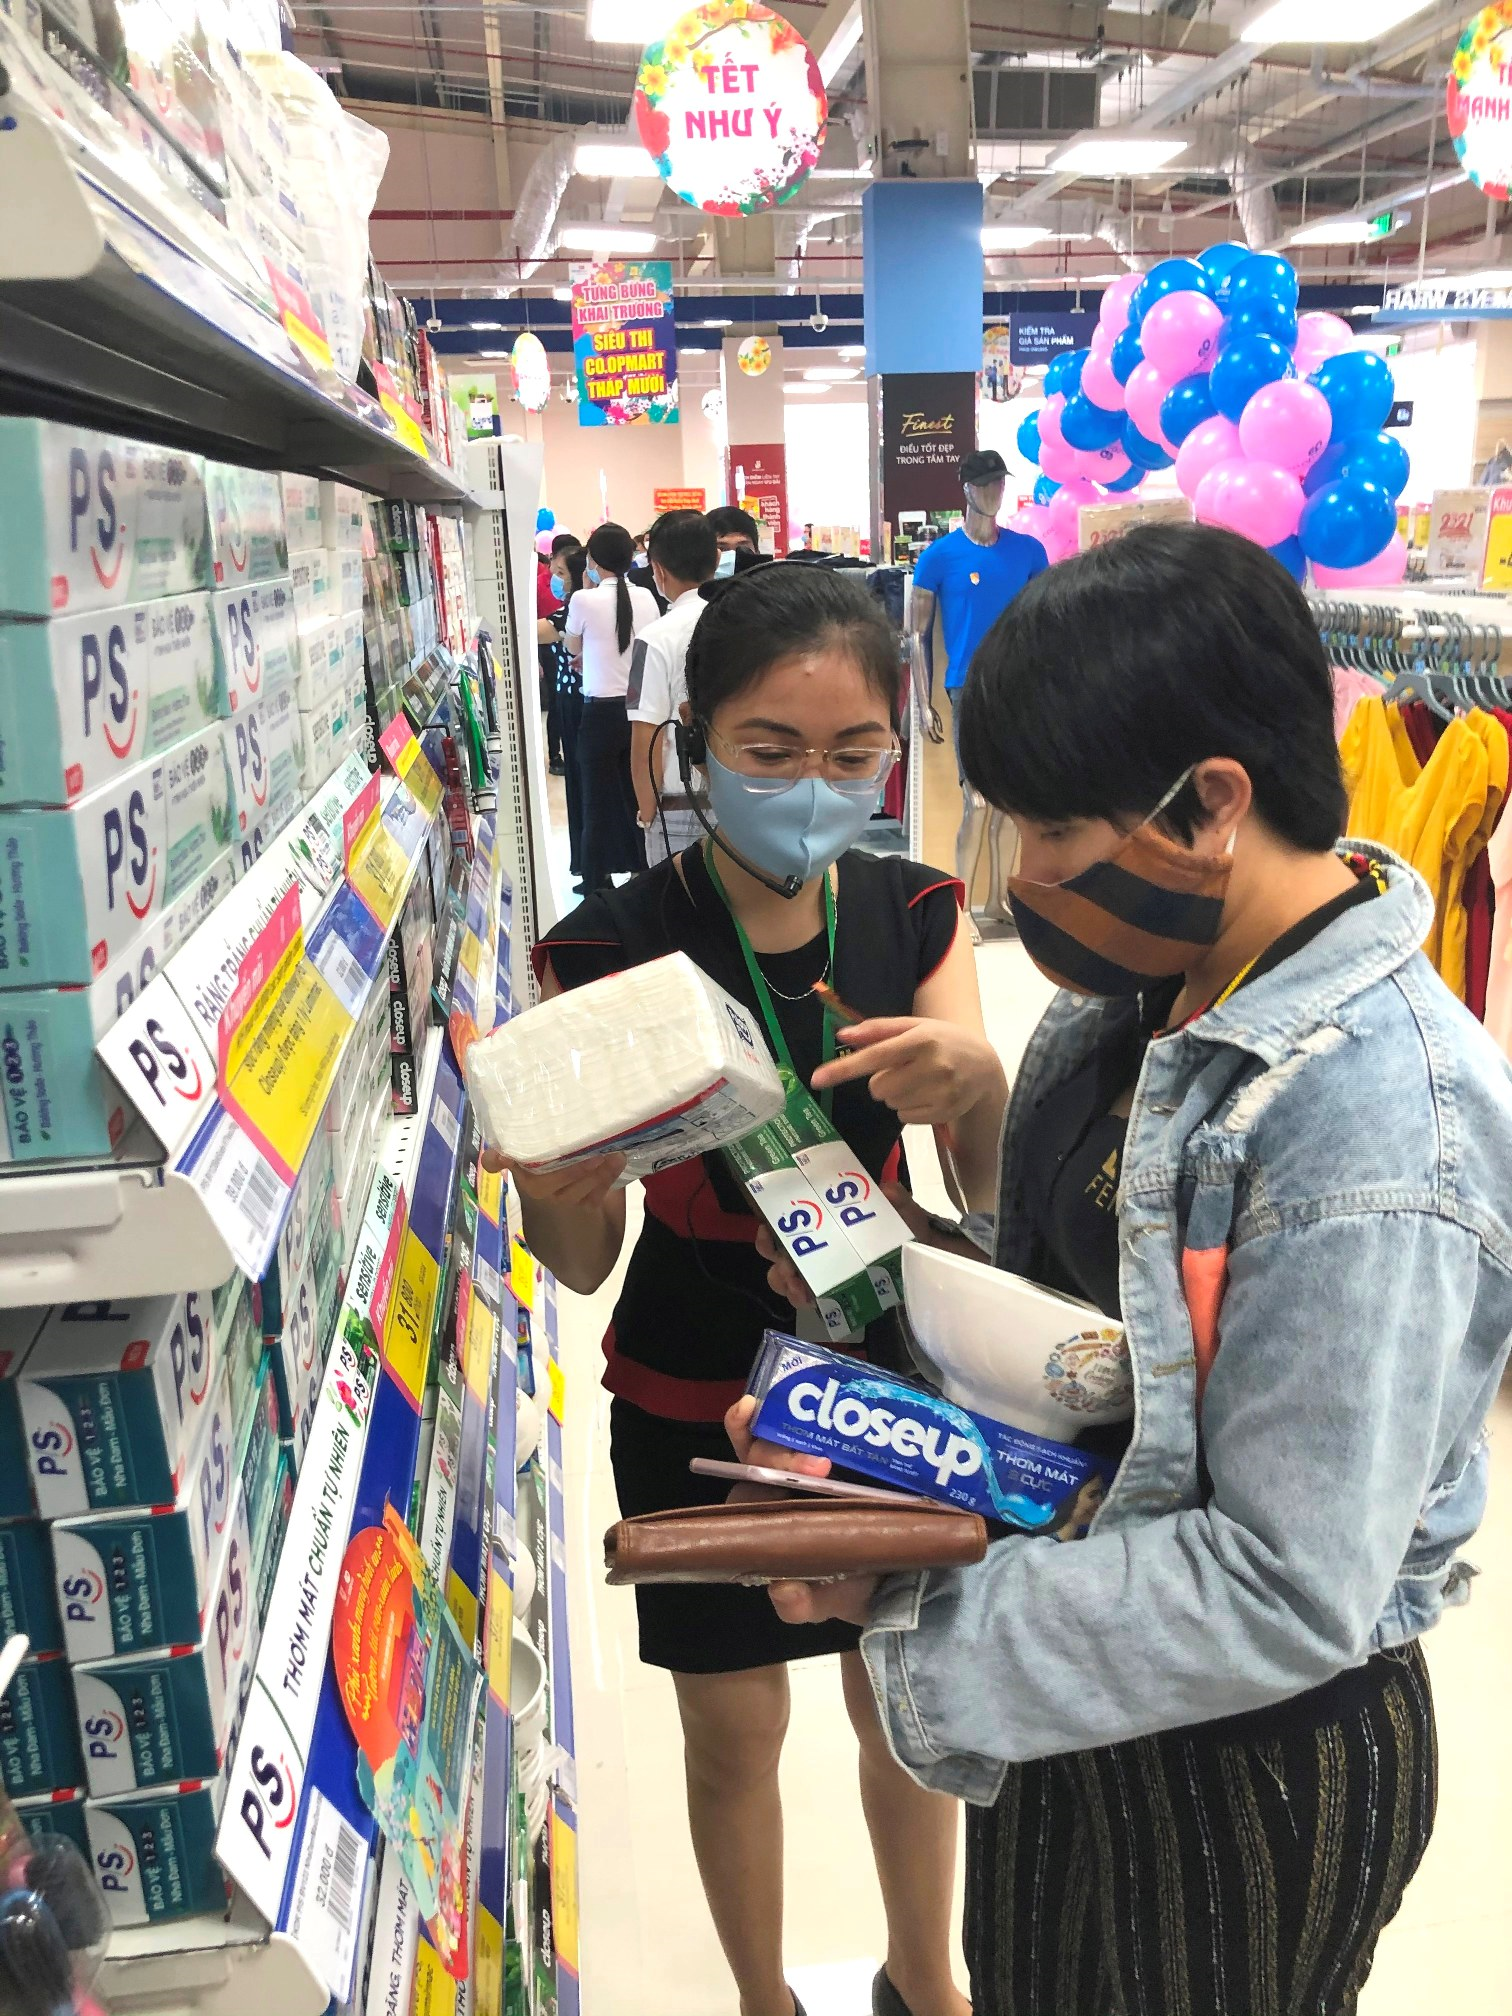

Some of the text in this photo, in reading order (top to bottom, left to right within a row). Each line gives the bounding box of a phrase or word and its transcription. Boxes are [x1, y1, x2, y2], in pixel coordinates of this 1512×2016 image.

[701, 52, 759, 94] TẾT
[685, 101, 782, 142] NHƯ Ý
[579, 305, 609, 322] KHAI
[1040, 327, 1056, 336] TRA
[594, 329, 653, 351] SIÊU THỊ
[1019, 336, 1033, 346] GIÁ
[1051, 333, 1074, 346] PHẨM
[585, 352, 665, 376] CO.OPMART
[588, 373, 666, 398] THÁP MƯỜI
[901, 412, 955, 434] Finest
[896, 455, 926, 465] TRONG
[946, 455, 961, 464] TAY
[921, 442, 937, 454] TỐT
[938, 443, 955, 455] ĐẸP
[70, 447, 117, 553] PS
[228, 597, 255, 675] PS
[81, 624, 129, 737] PS
[235, 713, 263, 794] PS
[103, 790, 149, 911] PS
[393, 1000, 406, 1046] closeup
[128, 1018, 188, 1107] PS
[400, 1060, 413, 1107] closeup
[808, 1117, 828, 1138] Green
[764, 1145, 780, 1165] Green
[374, 1174, 394, 1225] sensitive
[826, 1179, 877, 1228] PS
[778, 1208, 829, 1258] PS
[355, 1243, 378, 1305] sensitive
[170, 1292, 205, 1427] PS
[340, 1343, 355, 1372] PS
[781, 1356, 803, 1373] MỚI
[354, 1376, 368, 1403] PS
[32, 1426, 69, 1477] PS
[788, 1376, 982, 1487] closeup
[815, 1433, 841, 1448] MÁT
[996, 1449, 1079, 1486] THƠM MÁT
[950, 1487, 969, 1502] 230
[283, 1421, 350, 1697] THƠM MÁT CHUẨN TỰ NHIÊN
[62, 1572, 96, 1623] PS
[119, 1617, 134, 1644] BẢO
[84, 1717, 118, 1760] PS
[140, 1753, 156, 1778] BẢO
[240, 1745, 285, 1862] PS
[97, 1850, 130, 1892] PS
[315, 1857, 333, 1909] 32.000
[151, 1888, 167, 1912] BẢO
[391, 1877, 412, 1968] THƠM MÁT
[541, 1908, 552, 1969] closeup
